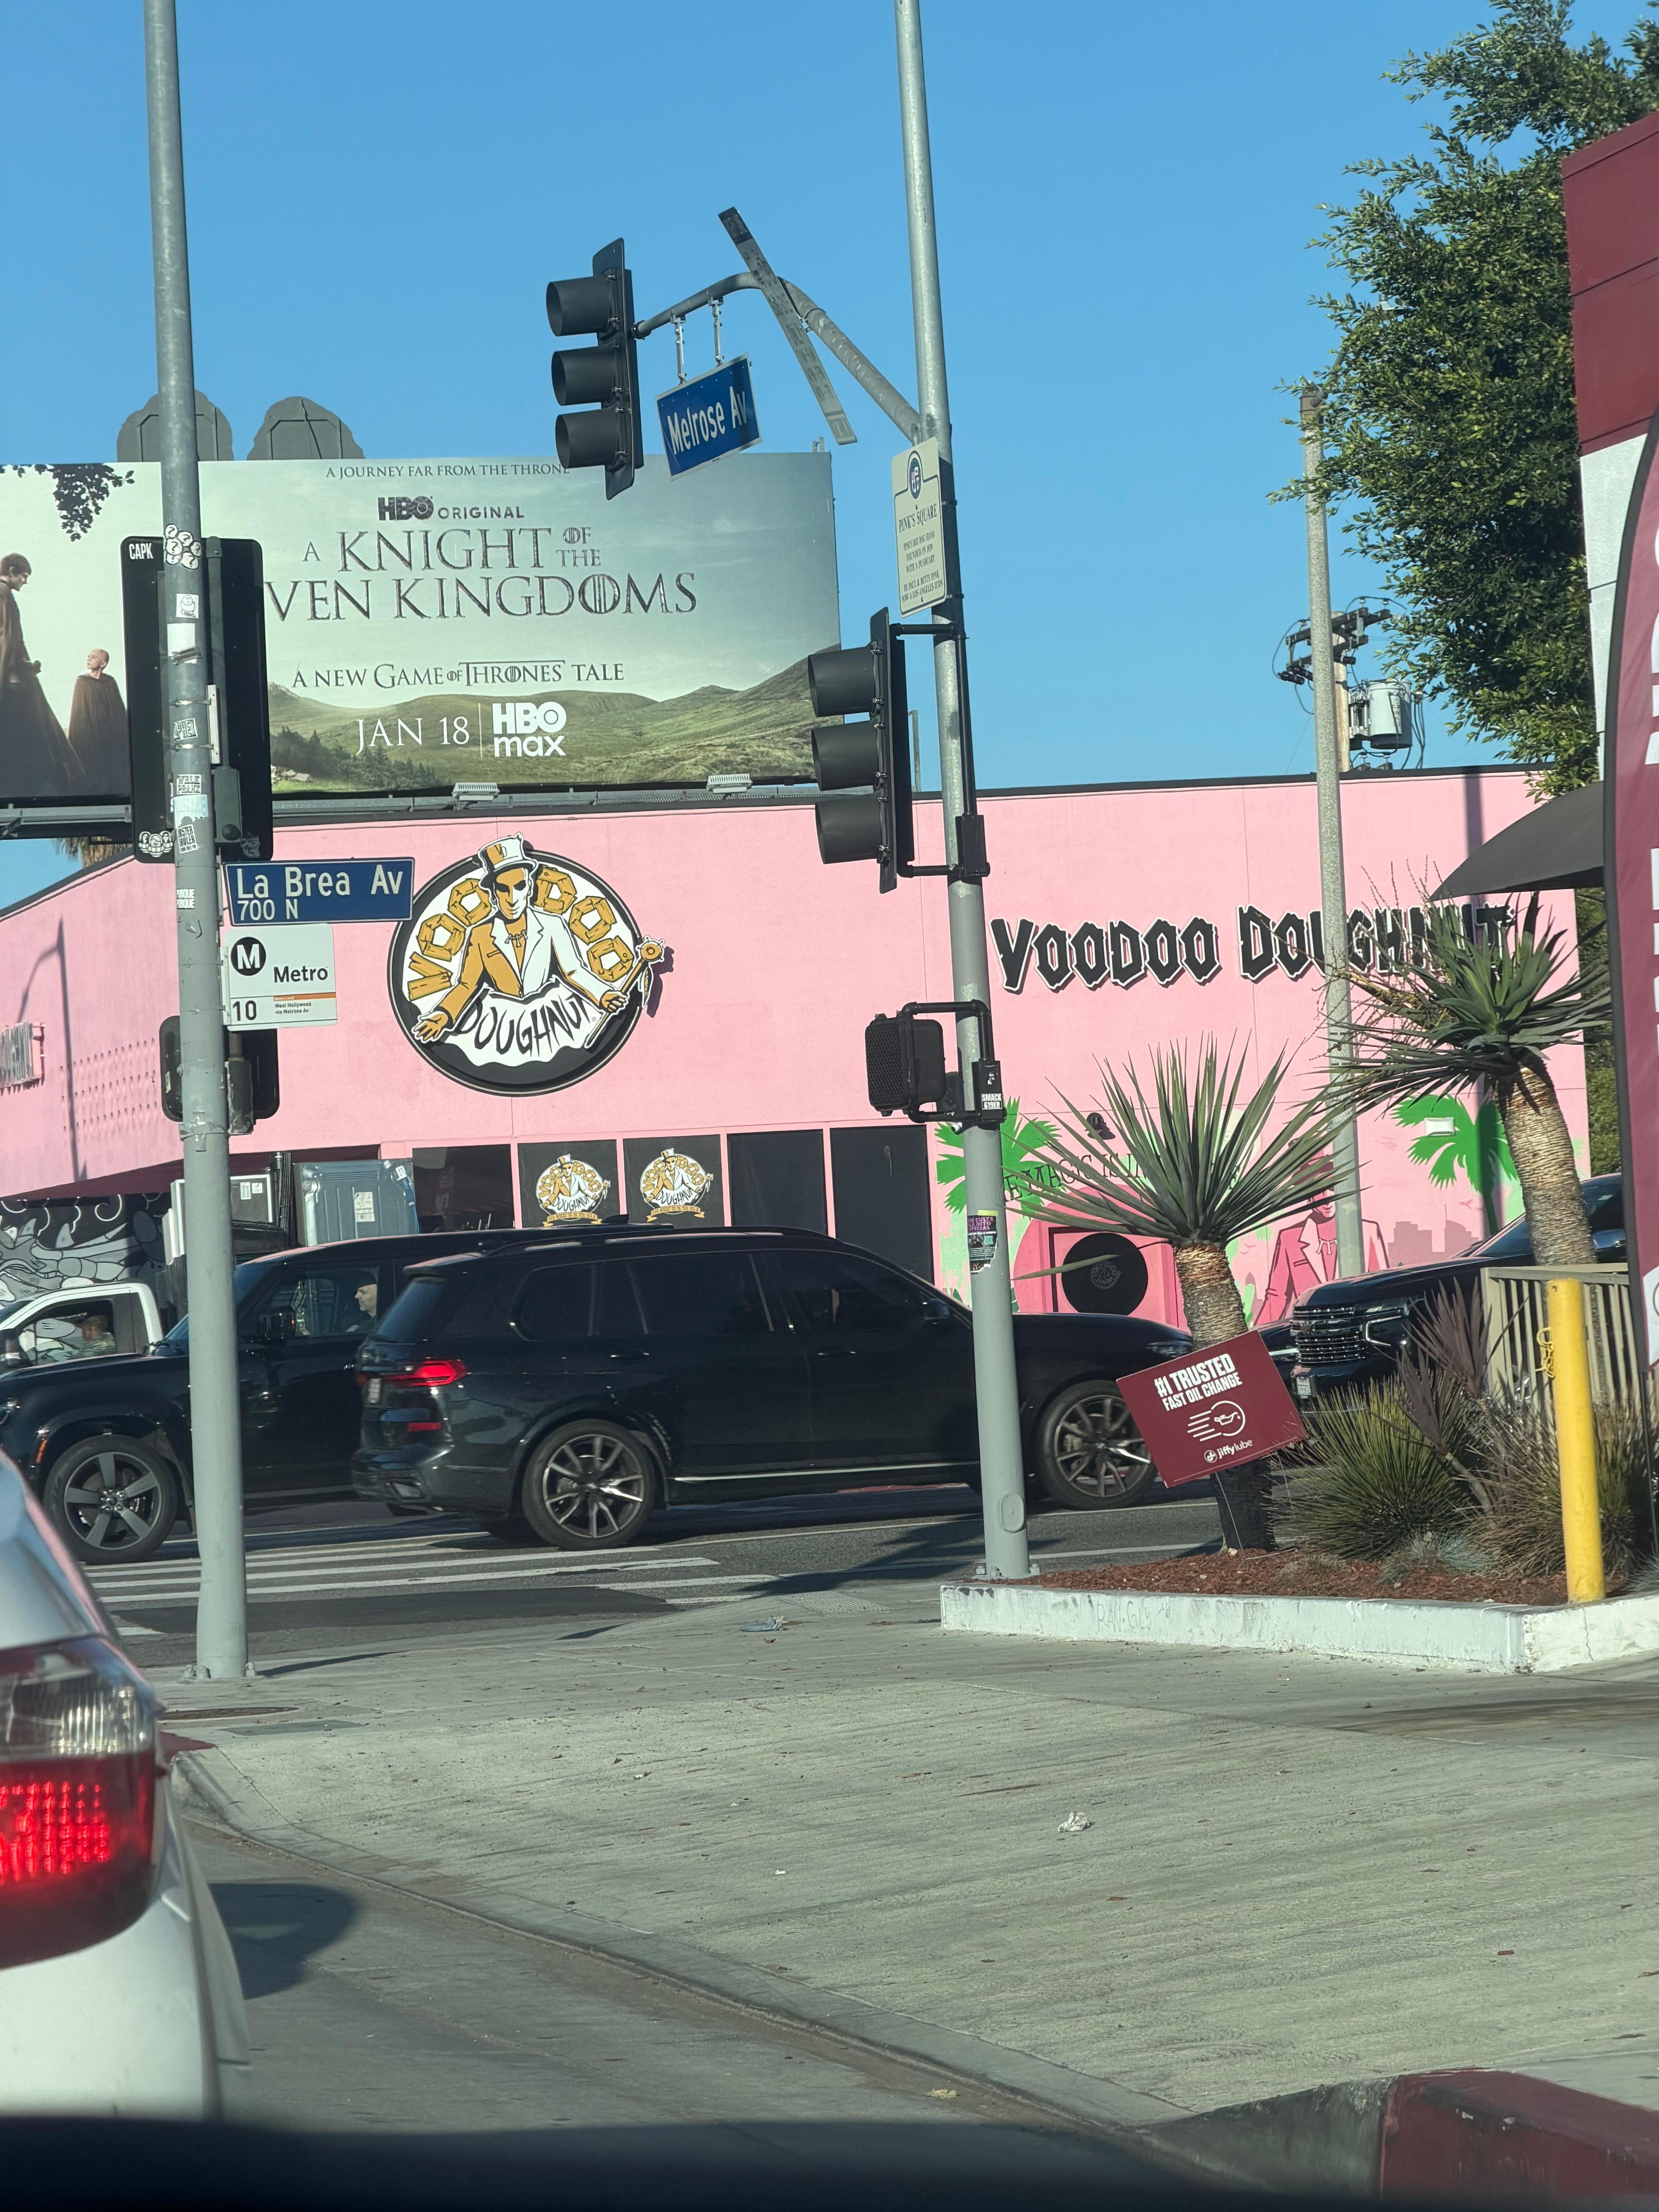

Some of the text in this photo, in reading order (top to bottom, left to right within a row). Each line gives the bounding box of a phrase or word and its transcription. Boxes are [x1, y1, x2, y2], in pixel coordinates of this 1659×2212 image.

[667, 386, 747, 455] Melrose Av
[326, 466, 335, 477] A
[339, 465, 403, 480] JOURNEY
[408, 465, 434, 477] FAR
[437, 465, 475, 476] FROM
[479, 464, 507, 476] THE
[377, 496, 524, 521] HBO ORIGINAL
[899, 503, 937, 532] PINK'S SQUARE
[129, 543, 153, 560] CAPK
[303, 526, 591, 572] A KNIGHT OF
[556, 549, 601, 567] THE
[264, 572, 697, 621] VEN KINGDOMS
[292, 659, 624, 689] A NEW GAME OF THRONES TALE
[492, 701, 567, 734] HBO
[356, 716, 469, 755] JAN 18
[494, 735, 566, 757] max
[237, 864, 403, 899] La Brea Av
[237, 899, 298, 921] 700 N
[236, 944, 260, 970] M
[990, 915, 1221, 992] VOODOO
[273, 965, 328, 983] Metro
[232, 1000, 257, 1021] 10
[455, 993, 591, 1058] DOUGHNUT
[551, 1195, 590, 1212] DOUGHNUT
[655, 1189, 693, 1206] DOUGHNUT
[1154, 1353, 1235, 1398] #1 TRUSTED
[1162, 1372, 1242, 1411] FAST OIL CHANGE
